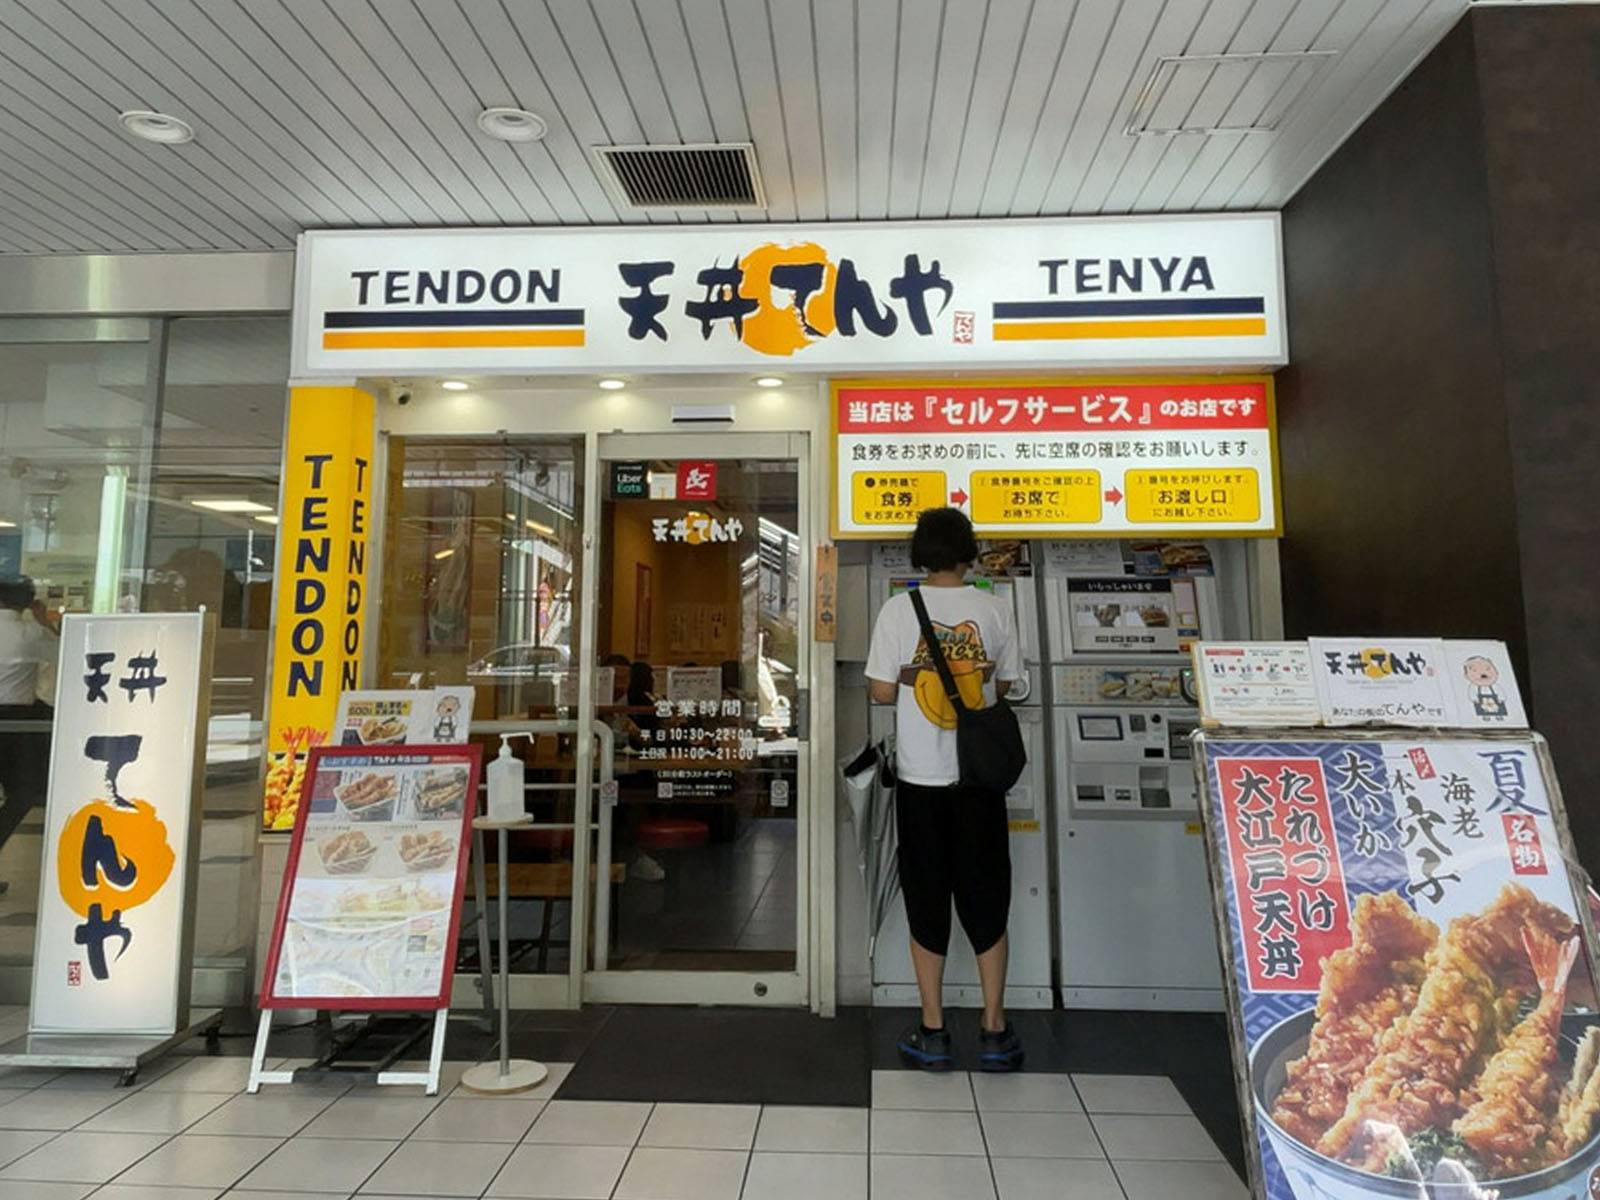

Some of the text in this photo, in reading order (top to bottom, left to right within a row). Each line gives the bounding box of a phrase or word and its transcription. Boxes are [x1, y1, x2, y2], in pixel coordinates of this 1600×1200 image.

[351, 268, 562, 306] TENDON
[618, 252, 953, 342] 天丼てんや
[1038, 256, 1215, 295] TENYA
[848, 395, 1257, 426] 当店は『セルフサービス』のお店です
[617, 473, 642, 483] Uber
[852, 440, 1259, 462] 食券をお求めの前に、先に空席の確認をお願いします。
[287, 453, 334, 699] TENDON
[341, 457, 368, 692] TENDON
[84, 649, 167, 703] 天丼
[654, 699, 741, 718] 営業時間
[1337, 749, 1391, 857] 大いか
[1440, 772, 1485, 840] 海老
[1478, 749, 1548, 817] 夏
[74, 734, 143, 980] てんや
[1235, 766, 1302, 980] 大江戸天丼
[1277, 766, 1337, 931] たれづけ
[1508, 818, 1542, 867] 名物
